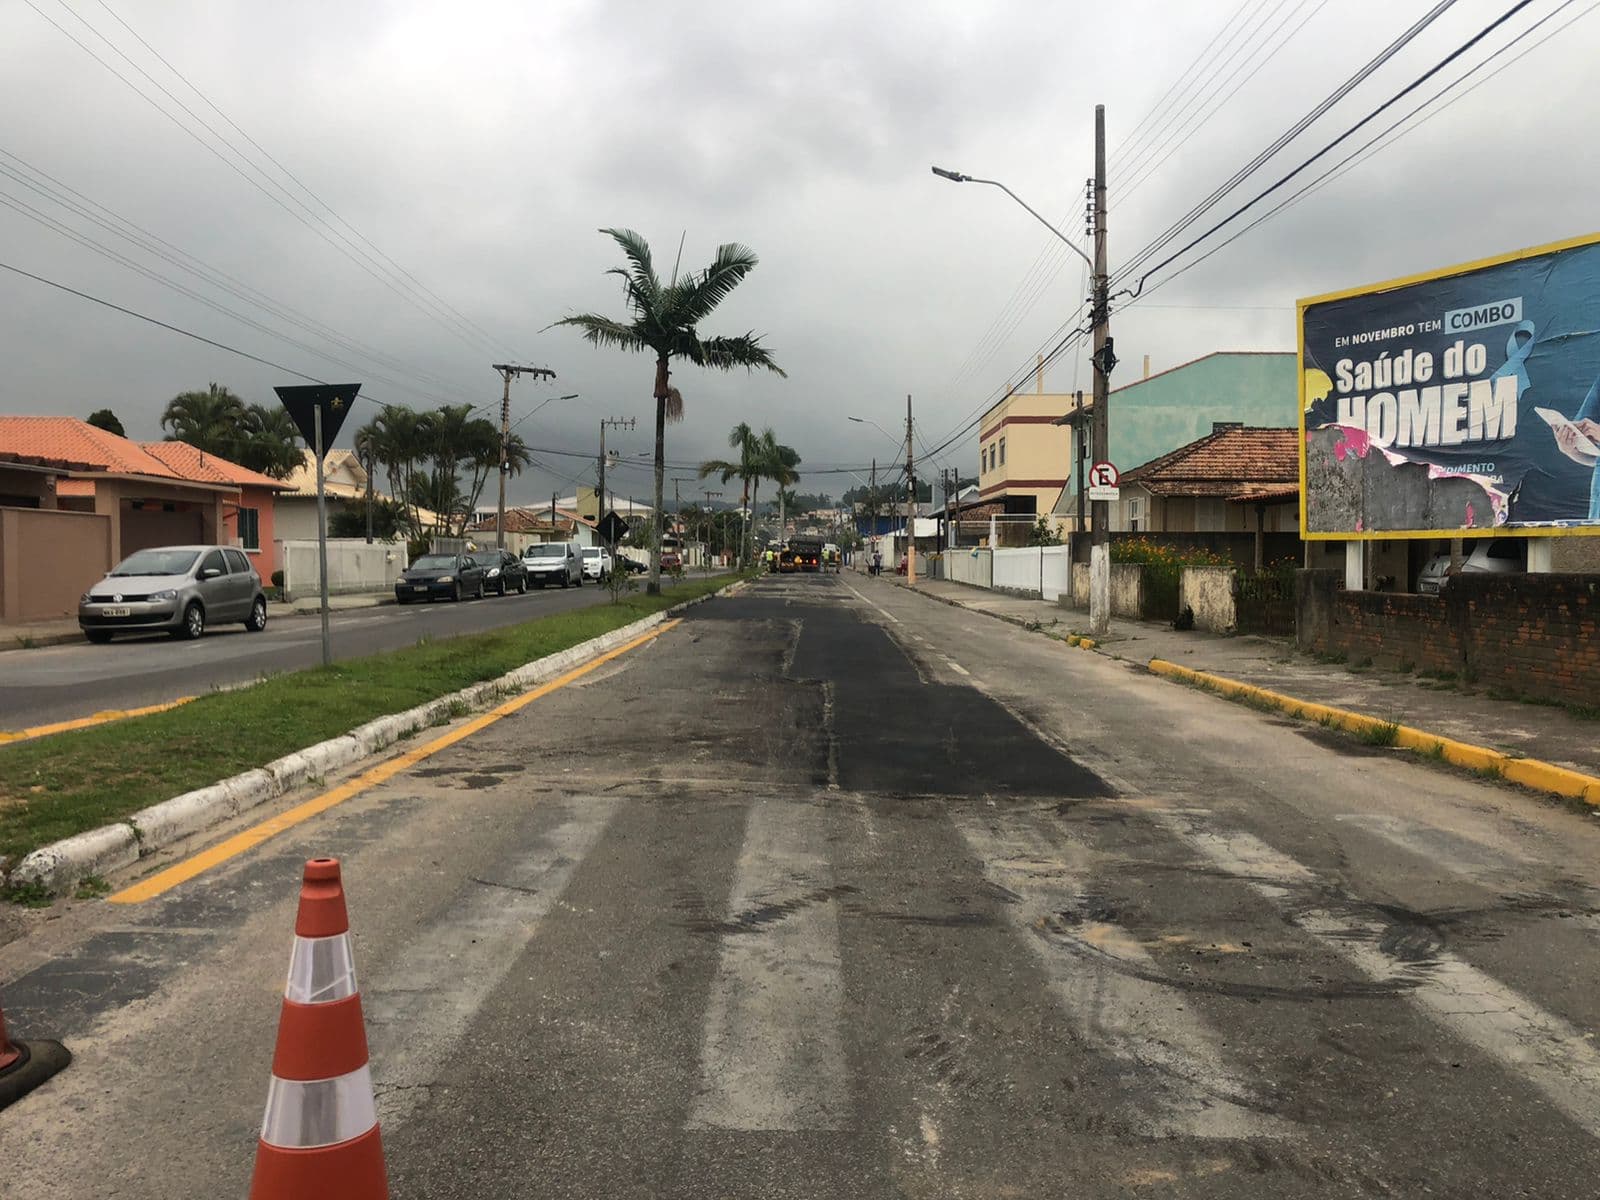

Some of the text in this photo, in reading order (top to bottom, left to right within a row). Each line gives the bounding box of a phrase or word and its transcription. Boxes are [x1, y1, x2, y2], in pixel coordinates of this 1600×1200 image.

[1335, 303, 1515, 348] EM NOVEMBRO TEM COMBO
[1335, 340, 1487, 394] Saúde do
[1337, 375, 1518, 448] HOMEM
[1441, 462, 1496, 474] DIMENTO
